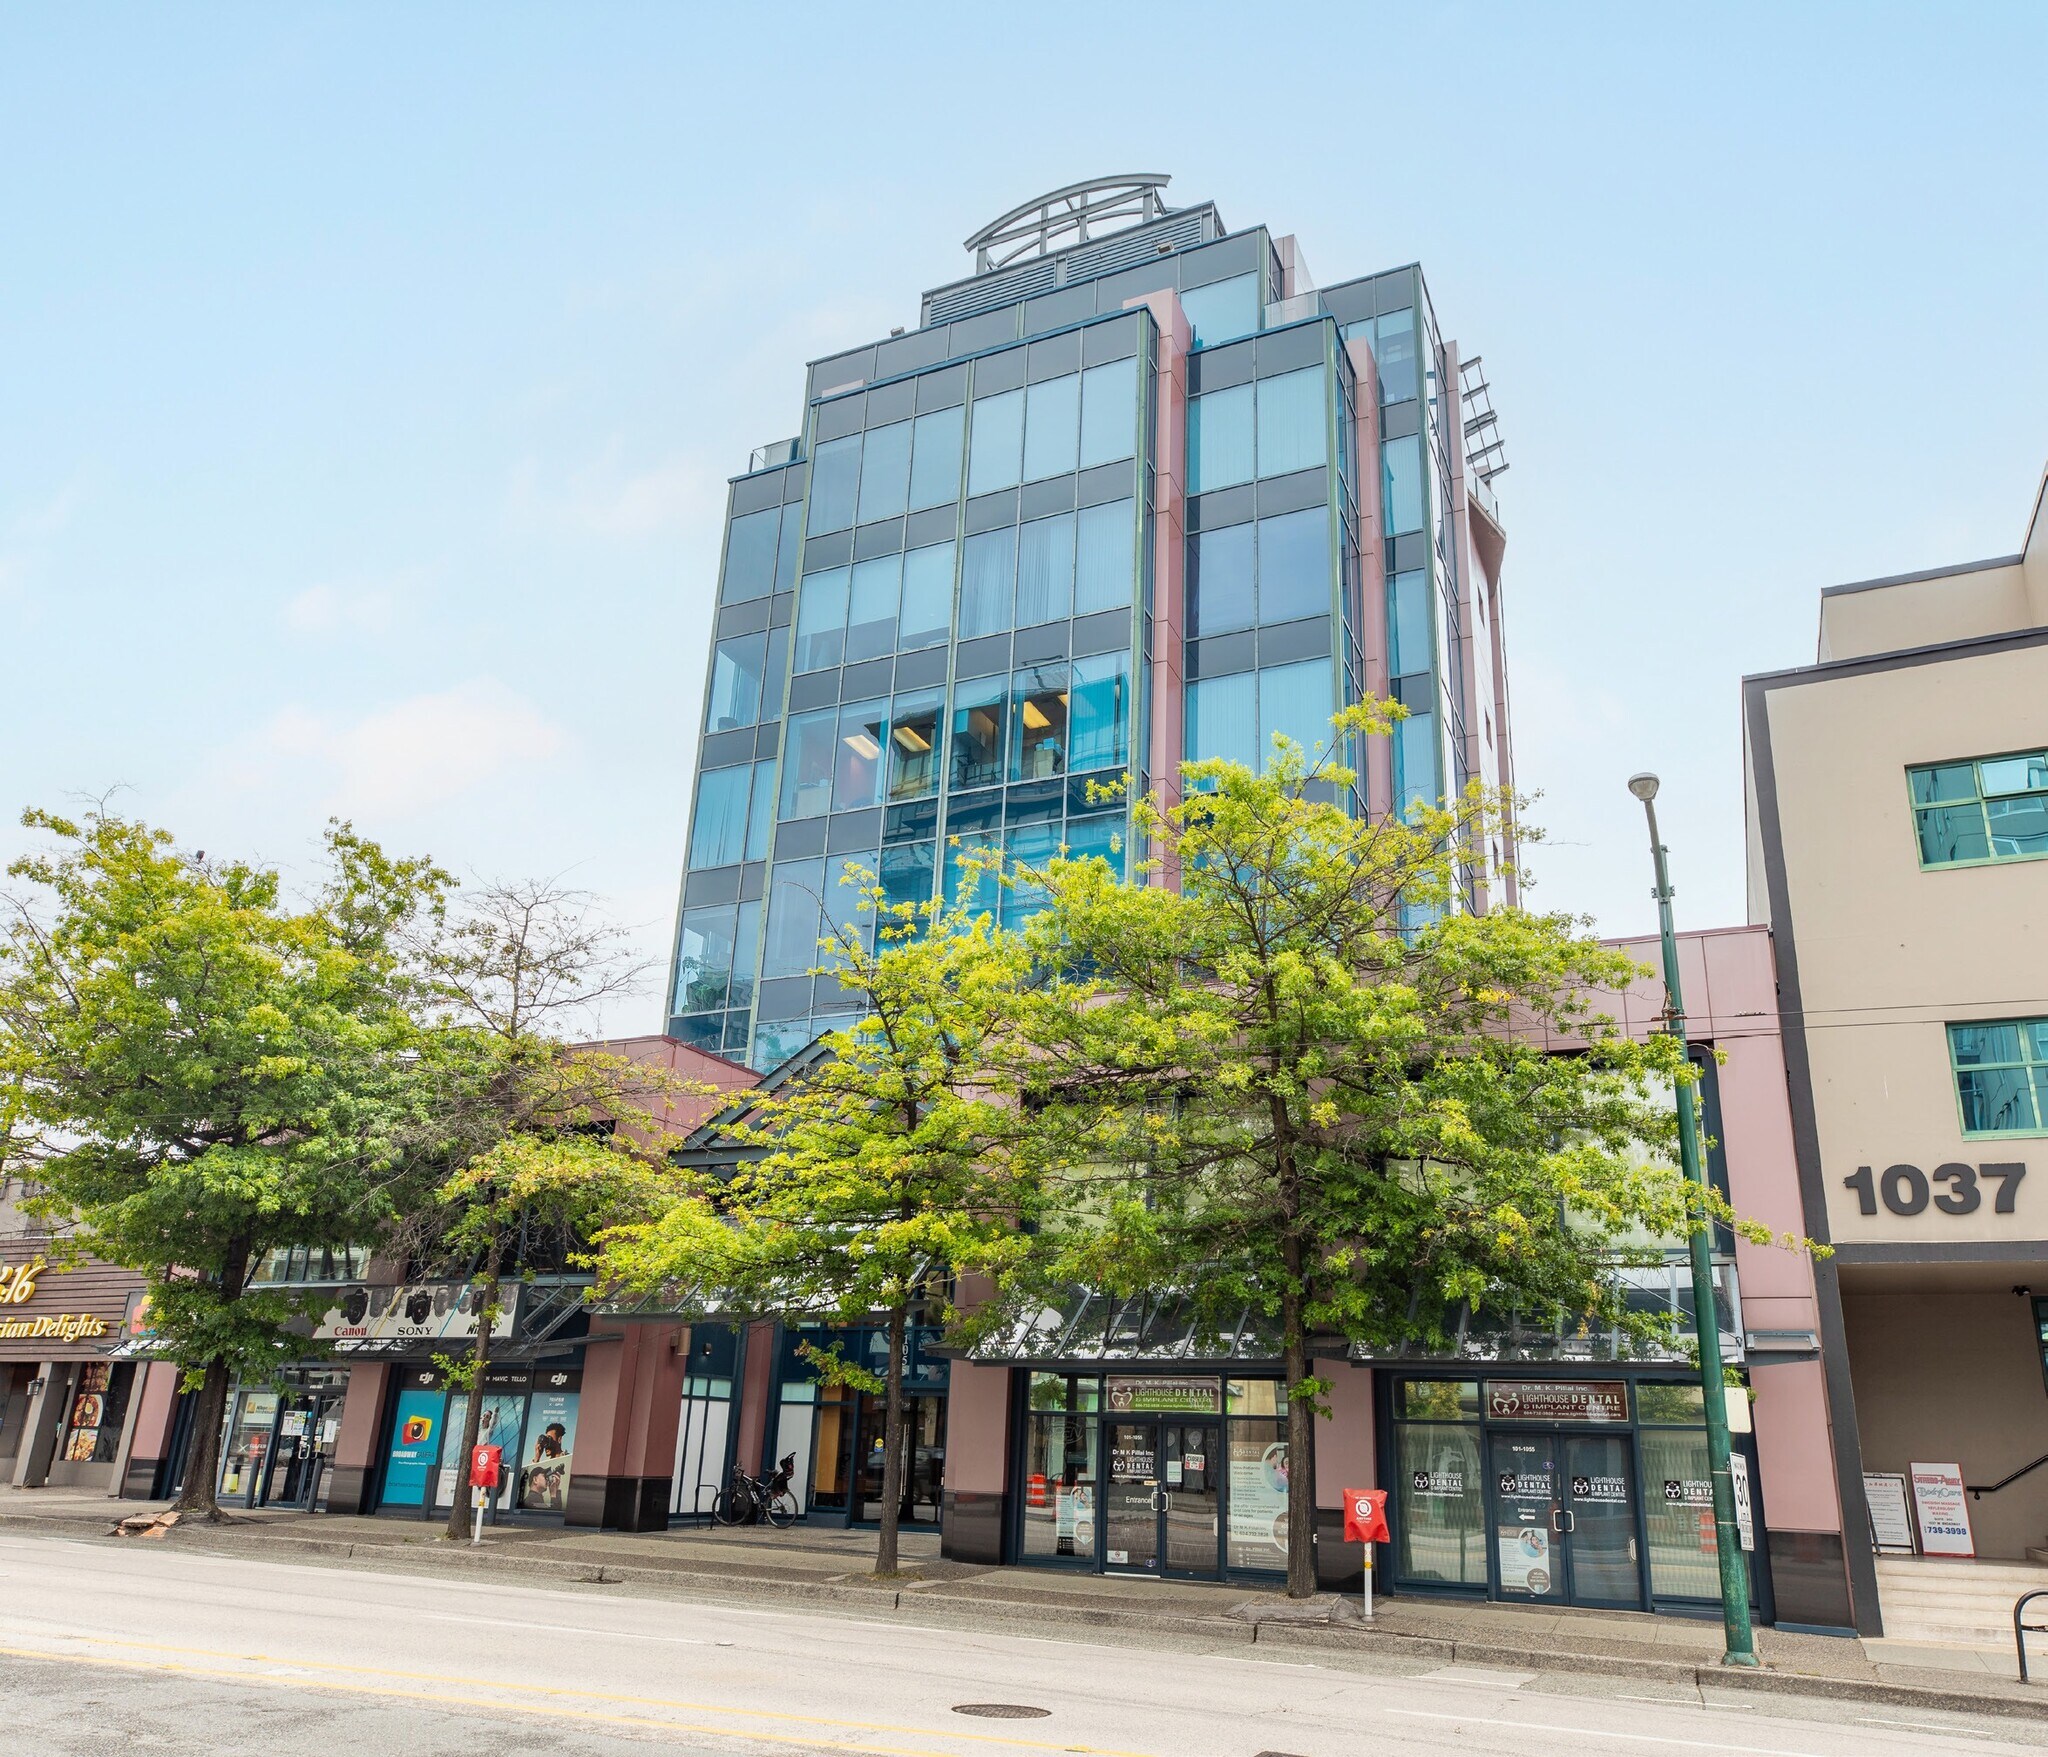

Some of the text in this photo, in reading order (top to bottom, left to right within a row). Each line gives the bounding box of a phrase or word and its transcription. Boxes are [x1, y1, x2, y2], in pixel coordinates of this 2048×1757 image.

[1844, 1162, 2027, 1216] 1037
[30, 1314, 109, 1343] Delights
[334, 1326, 367, 1336] Canon
[397, 1326, 433, 1336] SONY
[466, 1324, 496, 1334] Nin
[1135, 1388, 1214, 1397] LIGHTHOUSE DENTAL
[1522, 1394, 1620, 1404] LIGHTHOUSE DENTAL
[1430, 1471, 1463, 1480] LIGHTHOUSE
[1517, 1474, 1551, 1482] LIGHTHOUSE
[1430, 1479, 1463, 1487] DENTAL
[1590, 1476, 1625, 1485] LIGHTHOUSE
[1682, 1480, 1713, 1488] LIGHTHOU
[1517, 1481, 1552, 1490] DENTAL
[1591, 1484, 1626, 1493] DENTAL
[1683, 1488, 1714, 1496] DENTA
[1735, 1474, 1749, 1507] 30
